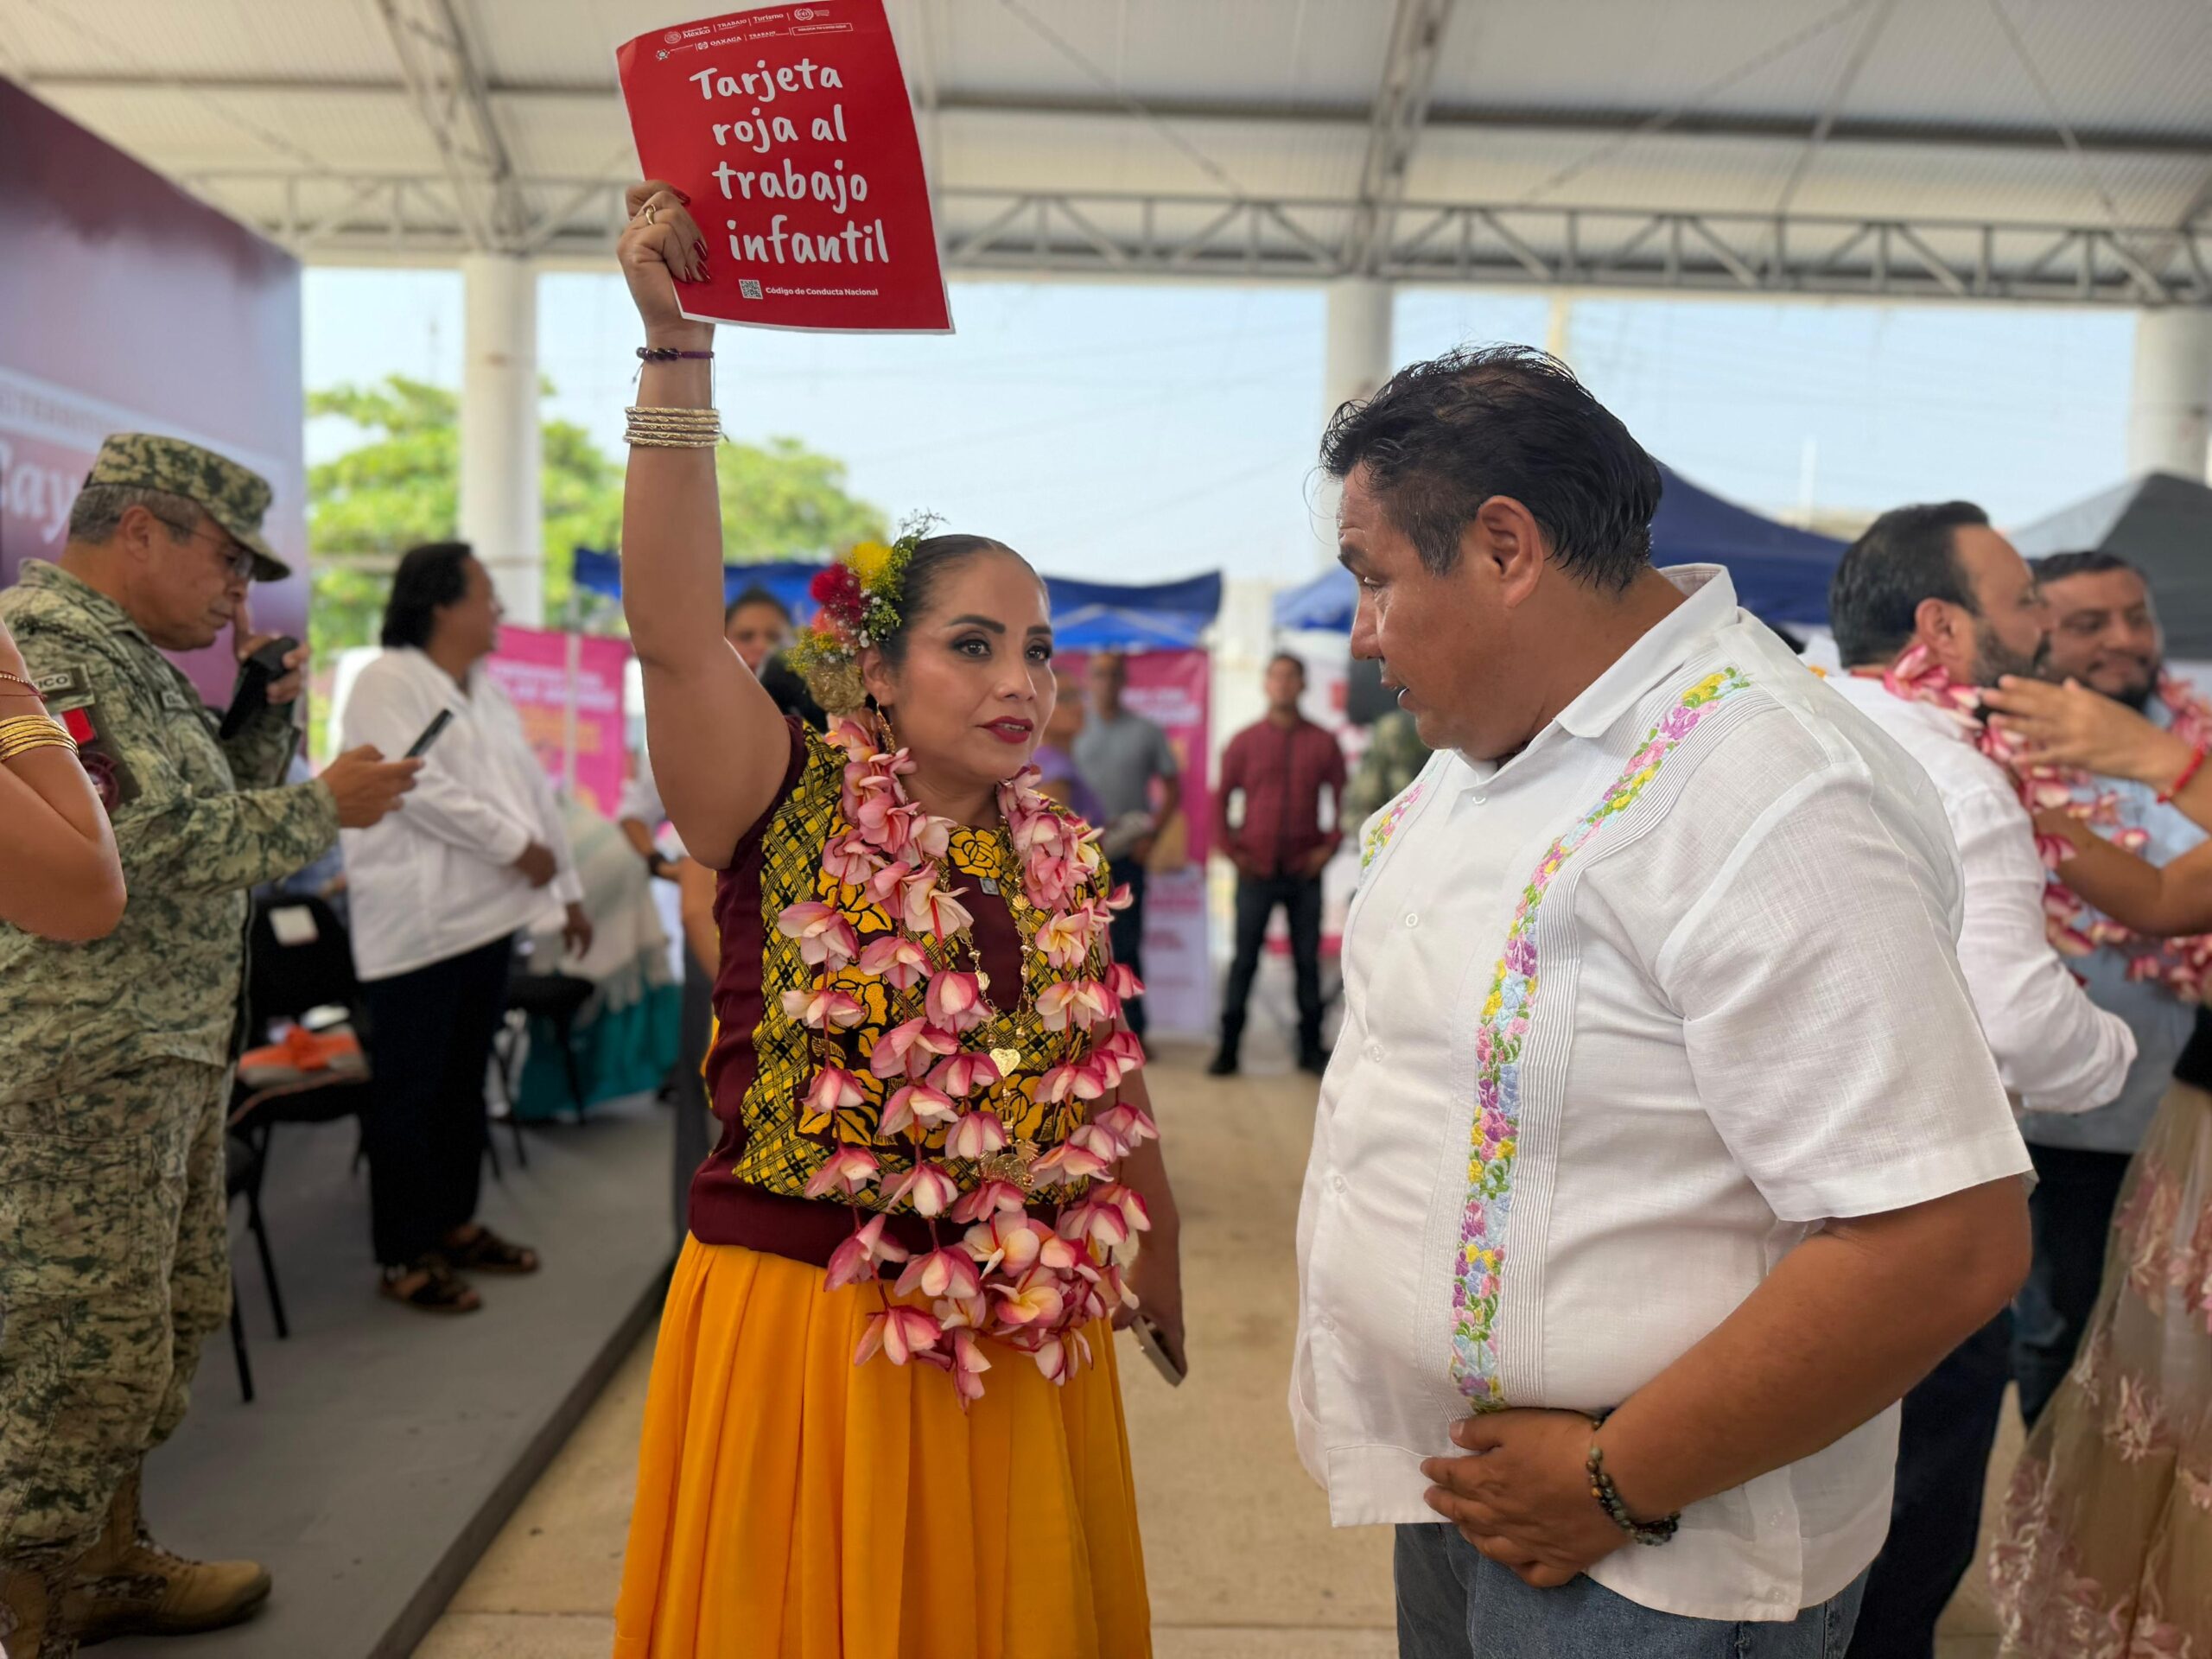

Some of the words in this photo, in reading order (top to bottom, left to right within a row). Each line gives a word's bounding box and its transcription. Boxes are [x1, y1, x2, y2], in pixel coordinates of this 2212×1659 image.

[717, 19, 747, 28] TRABAJO
[753, 13, 784, 22] Turismo
[710, 36, 742, 46] OAXACA
[690, 58, 843, 102] Tarjeta
[712, 107, 799, 153] roja
[811, 104, 848, 142] al
[711, 158, 868, 213] trabajo
[727, 214, 889, 264] infantil
[765, 287, 794, 296] Código
